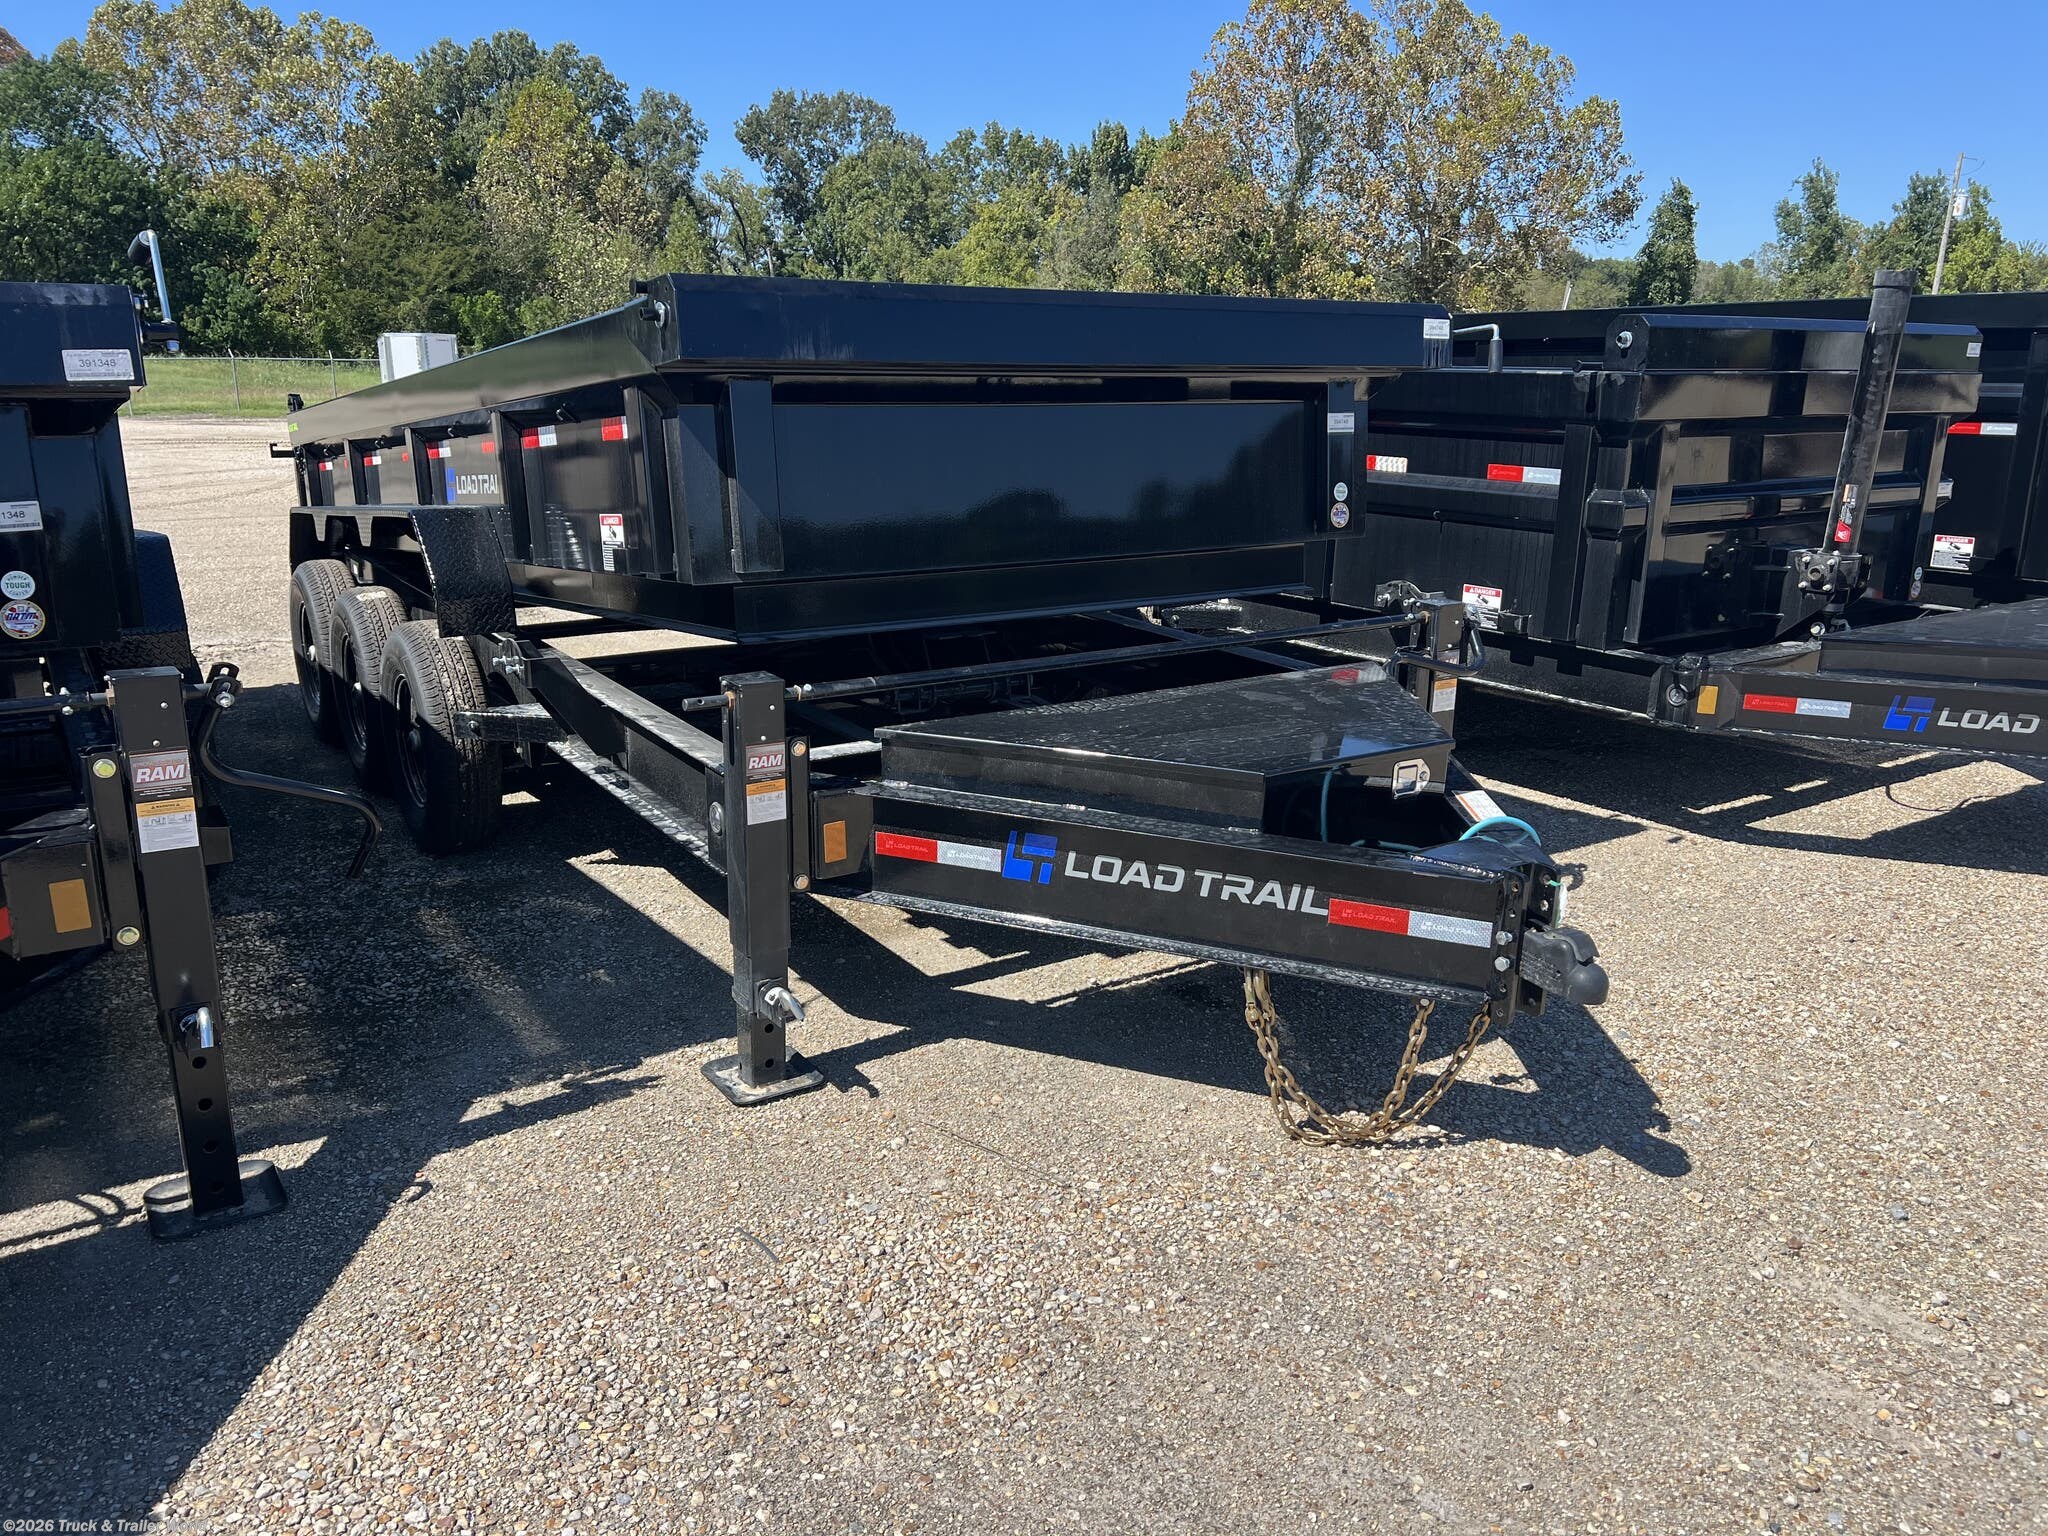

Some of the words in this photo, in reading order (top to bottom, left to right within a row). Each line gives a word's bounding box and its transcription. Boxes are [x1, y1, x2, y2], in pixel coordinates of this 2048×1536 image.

[79, 359, 117, 368] 391348
[455, 475, 478, 495] LOAD
[478, 474, 499, 495] TRAI
[1937, 707, 2041, 734] LOAD
[748, 754, 782, 769] RAM
[136, 764, 185, 783] RAM
[1064, 851, 1185, 893] LOAD
[1194, 868, 1329, 916] TRAIL
